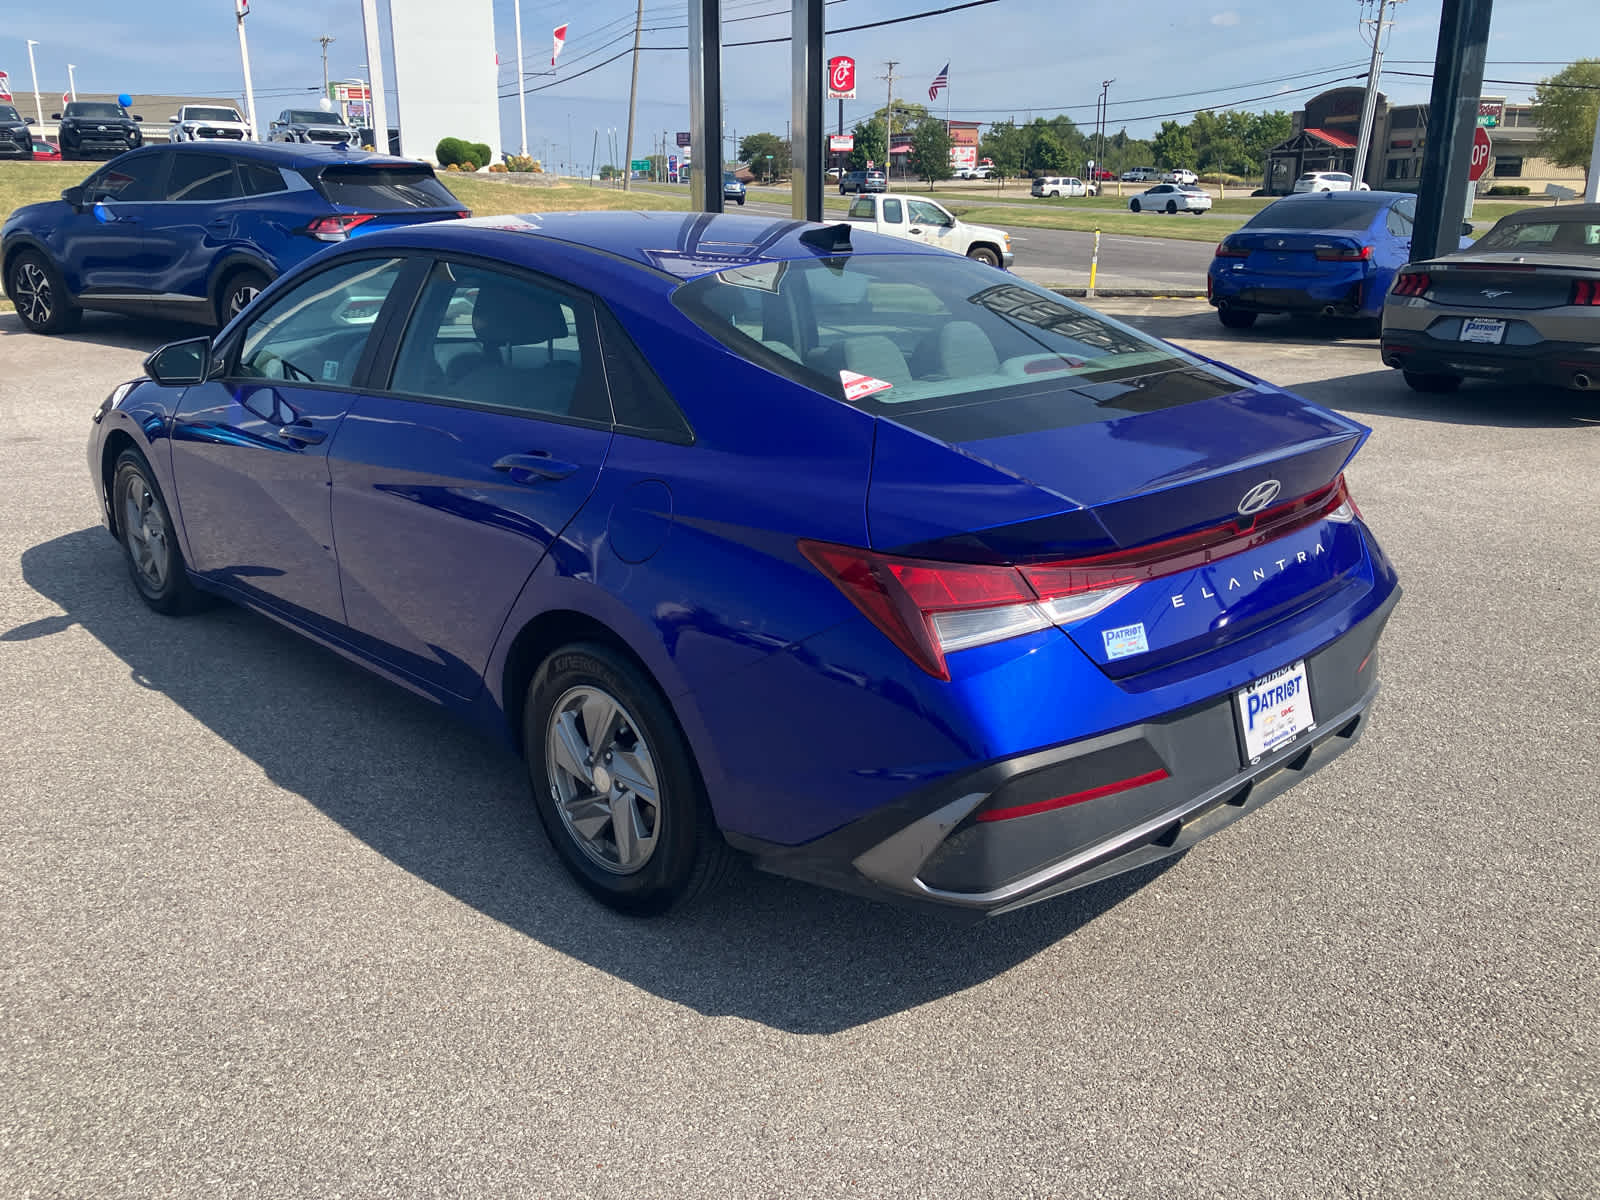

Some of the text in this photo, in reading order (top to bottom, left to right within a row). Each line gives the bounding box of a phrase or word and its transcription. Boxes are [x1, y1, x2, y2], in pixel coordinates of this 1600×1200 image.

[1471, 144, 1488, 166] OP
[1464, 322, 1503, 333] PATRIOT
[1171, 543, 1326, 609] ELANTRA
[1106, 626, 1142, 647] PATRIOT
[1247, 675, 1303, 731] PATRIOT
